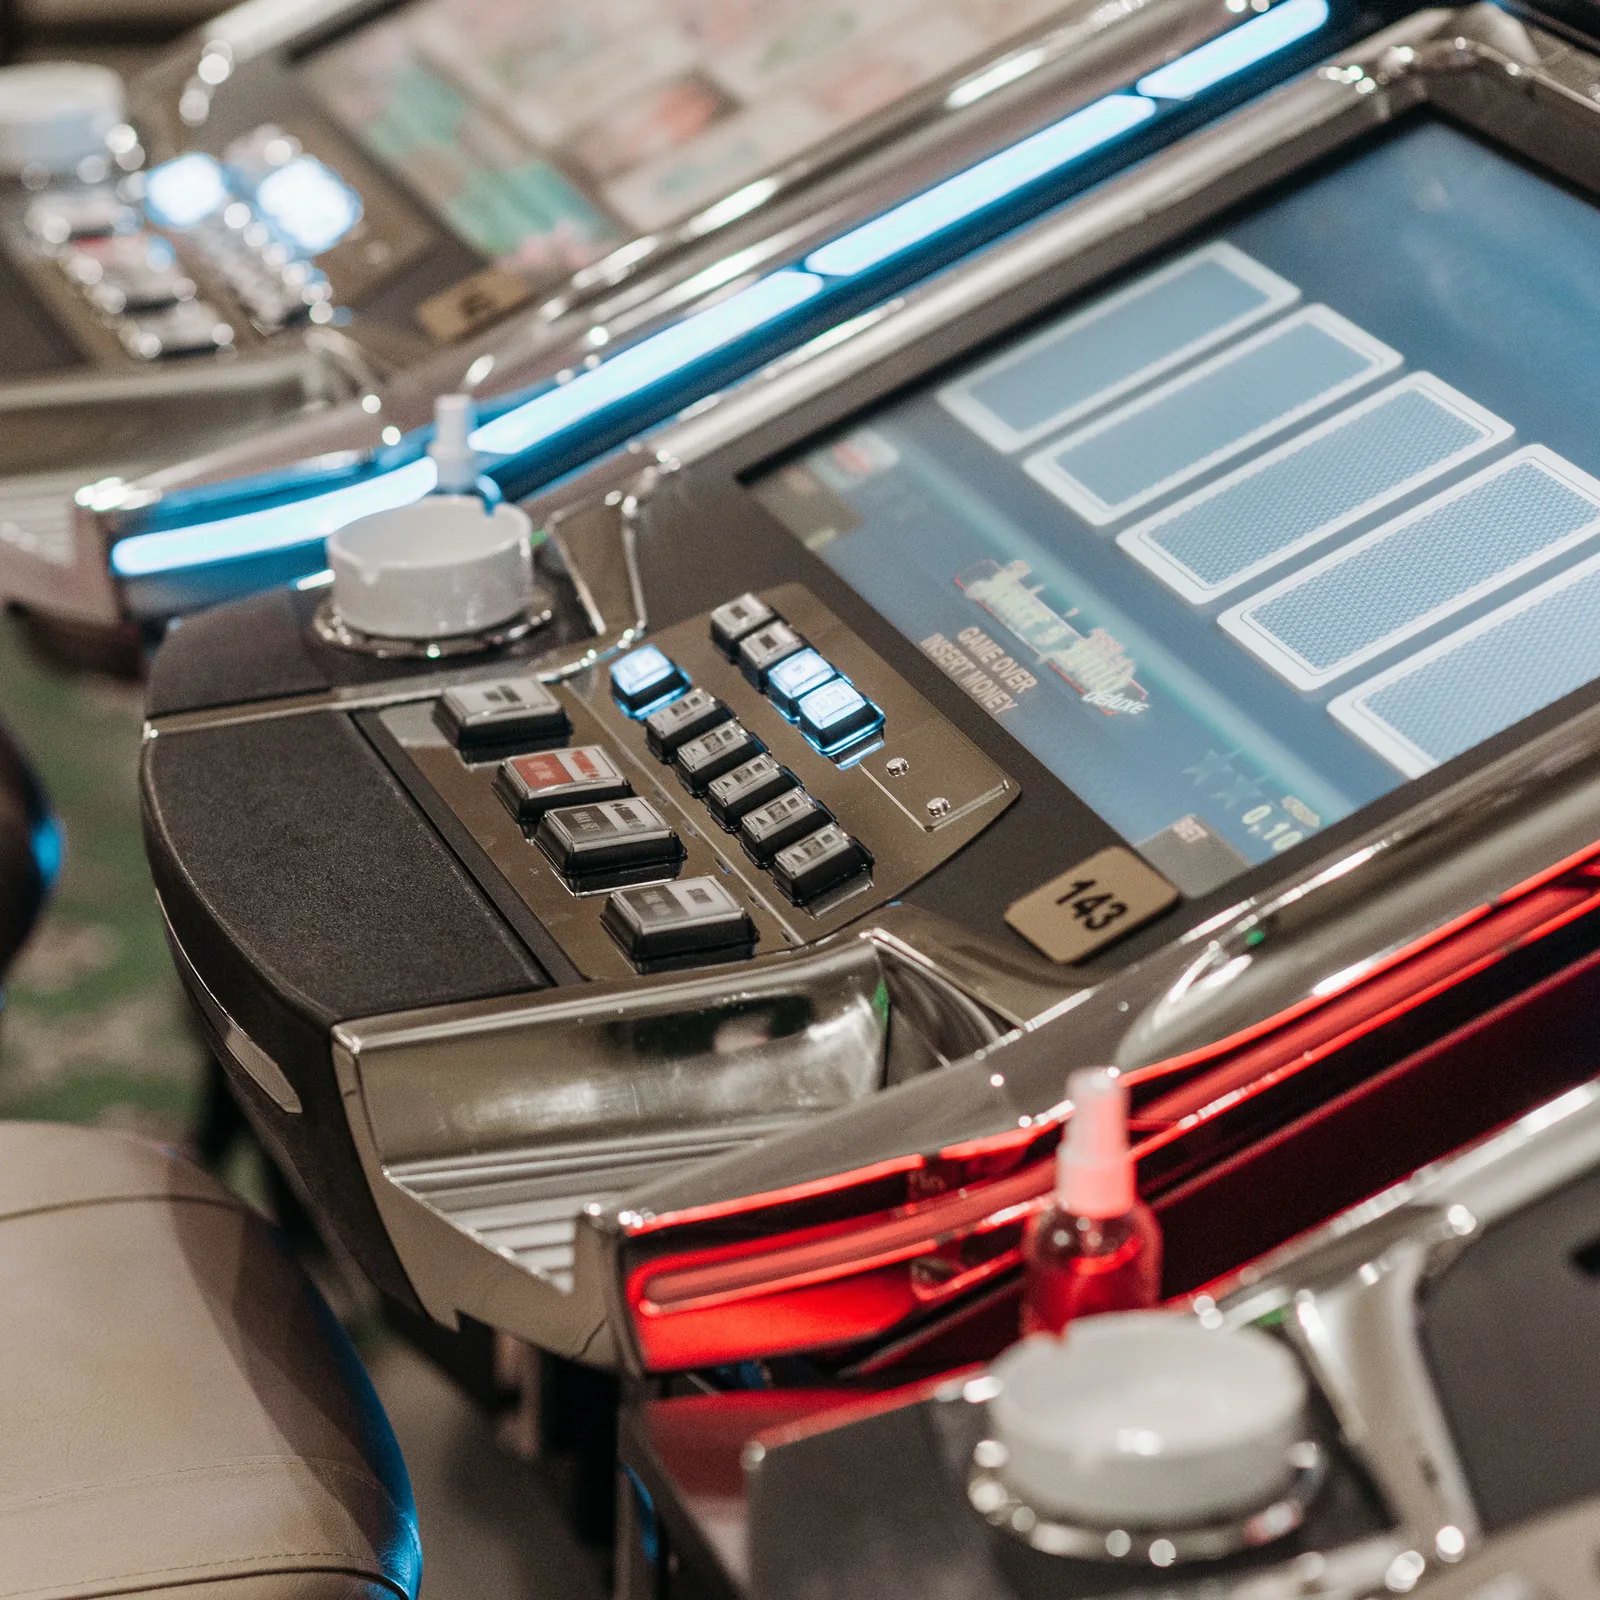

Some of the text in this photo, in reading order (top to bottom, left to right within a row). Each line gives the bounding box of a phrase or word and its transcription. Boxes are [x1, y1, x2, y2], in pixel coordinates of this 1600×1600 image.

[920, 632, 1020, 714] INSERT MONEY
[957, 627, 1005, 664] GAME
[992, 656, 1038, 695] OVER
[1056, 879, 1128, 931] 143
